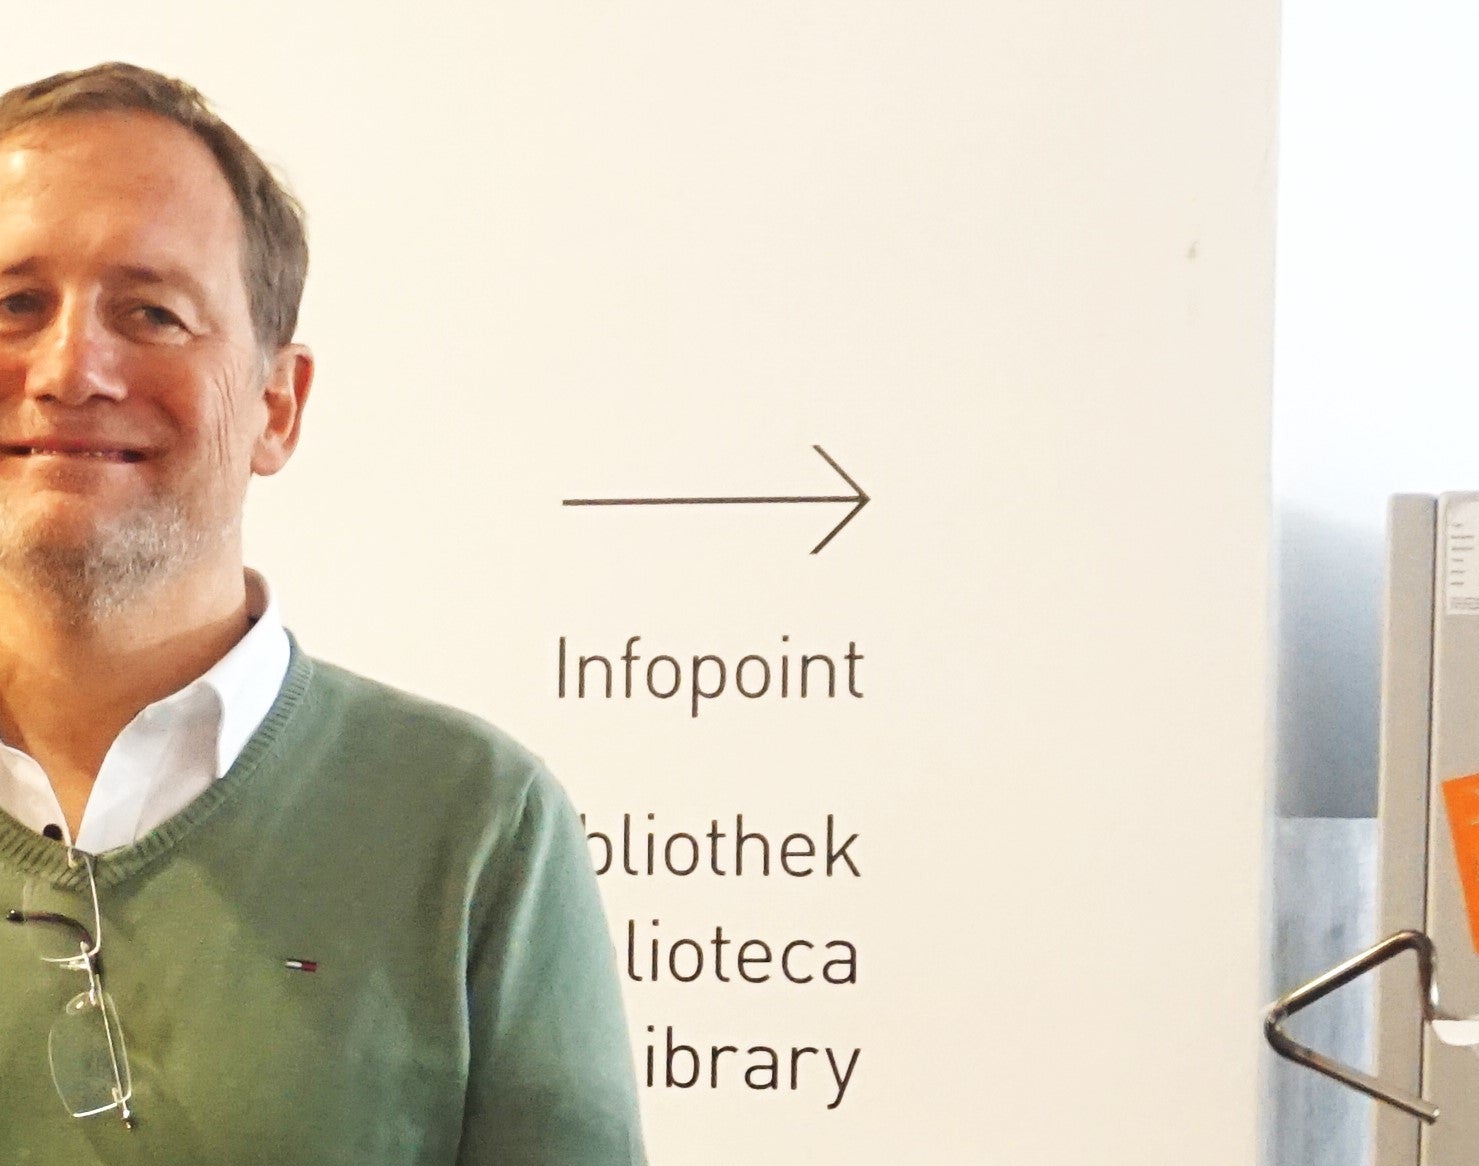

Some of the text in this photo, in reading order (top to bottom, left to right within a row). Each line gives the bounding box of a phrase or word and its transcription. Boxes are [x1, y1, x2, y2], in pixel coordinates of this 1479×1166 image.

[558, 634, 865, 719] Infopoint
[627, 918, 857, 985] lioteca
[646, 1024, 862, 1111] ibrary
